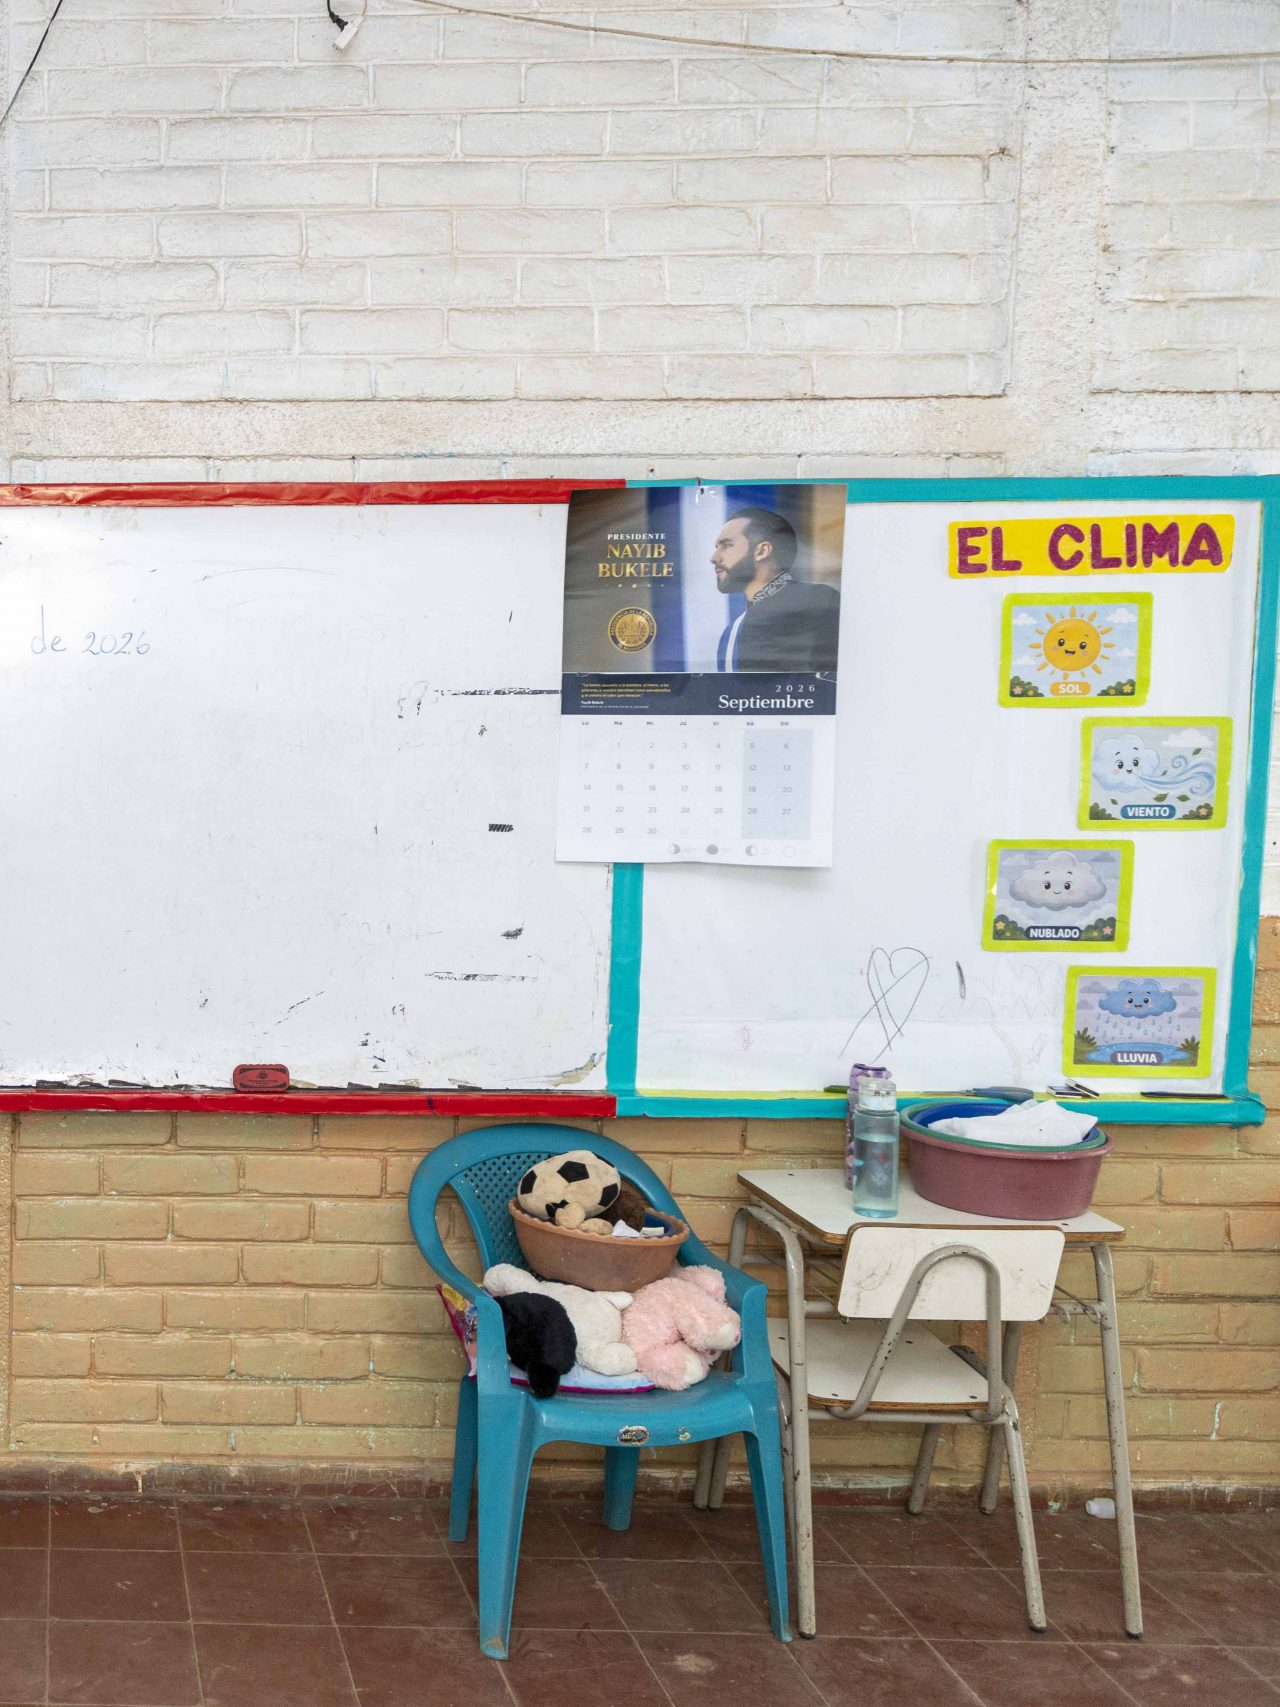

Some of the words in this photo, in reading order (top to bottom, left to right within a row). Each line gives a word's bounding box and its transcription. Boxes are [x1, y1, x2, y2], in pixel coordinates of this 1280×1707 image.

[607, 543, 666, 559] NAYIB
[957, 526, 1022, 573] EL
[1048, 522, 1223, 571] CLIMA
[597, 562, 674, 578] BUKELE
[30, 604, 68, 654] de
[82, 627, 151, 656] 2026
[775, 684, 815, 693] 2026
[1059, 683, 1082, 694] SOL
[718, 694, 815, 712] Septiembre
[1126, 806, 1170, 818] VIENTO
[1029, 928, 1080, 939] NUBLADO
[1116, 1052, 1158, 1064] LLUVIA
